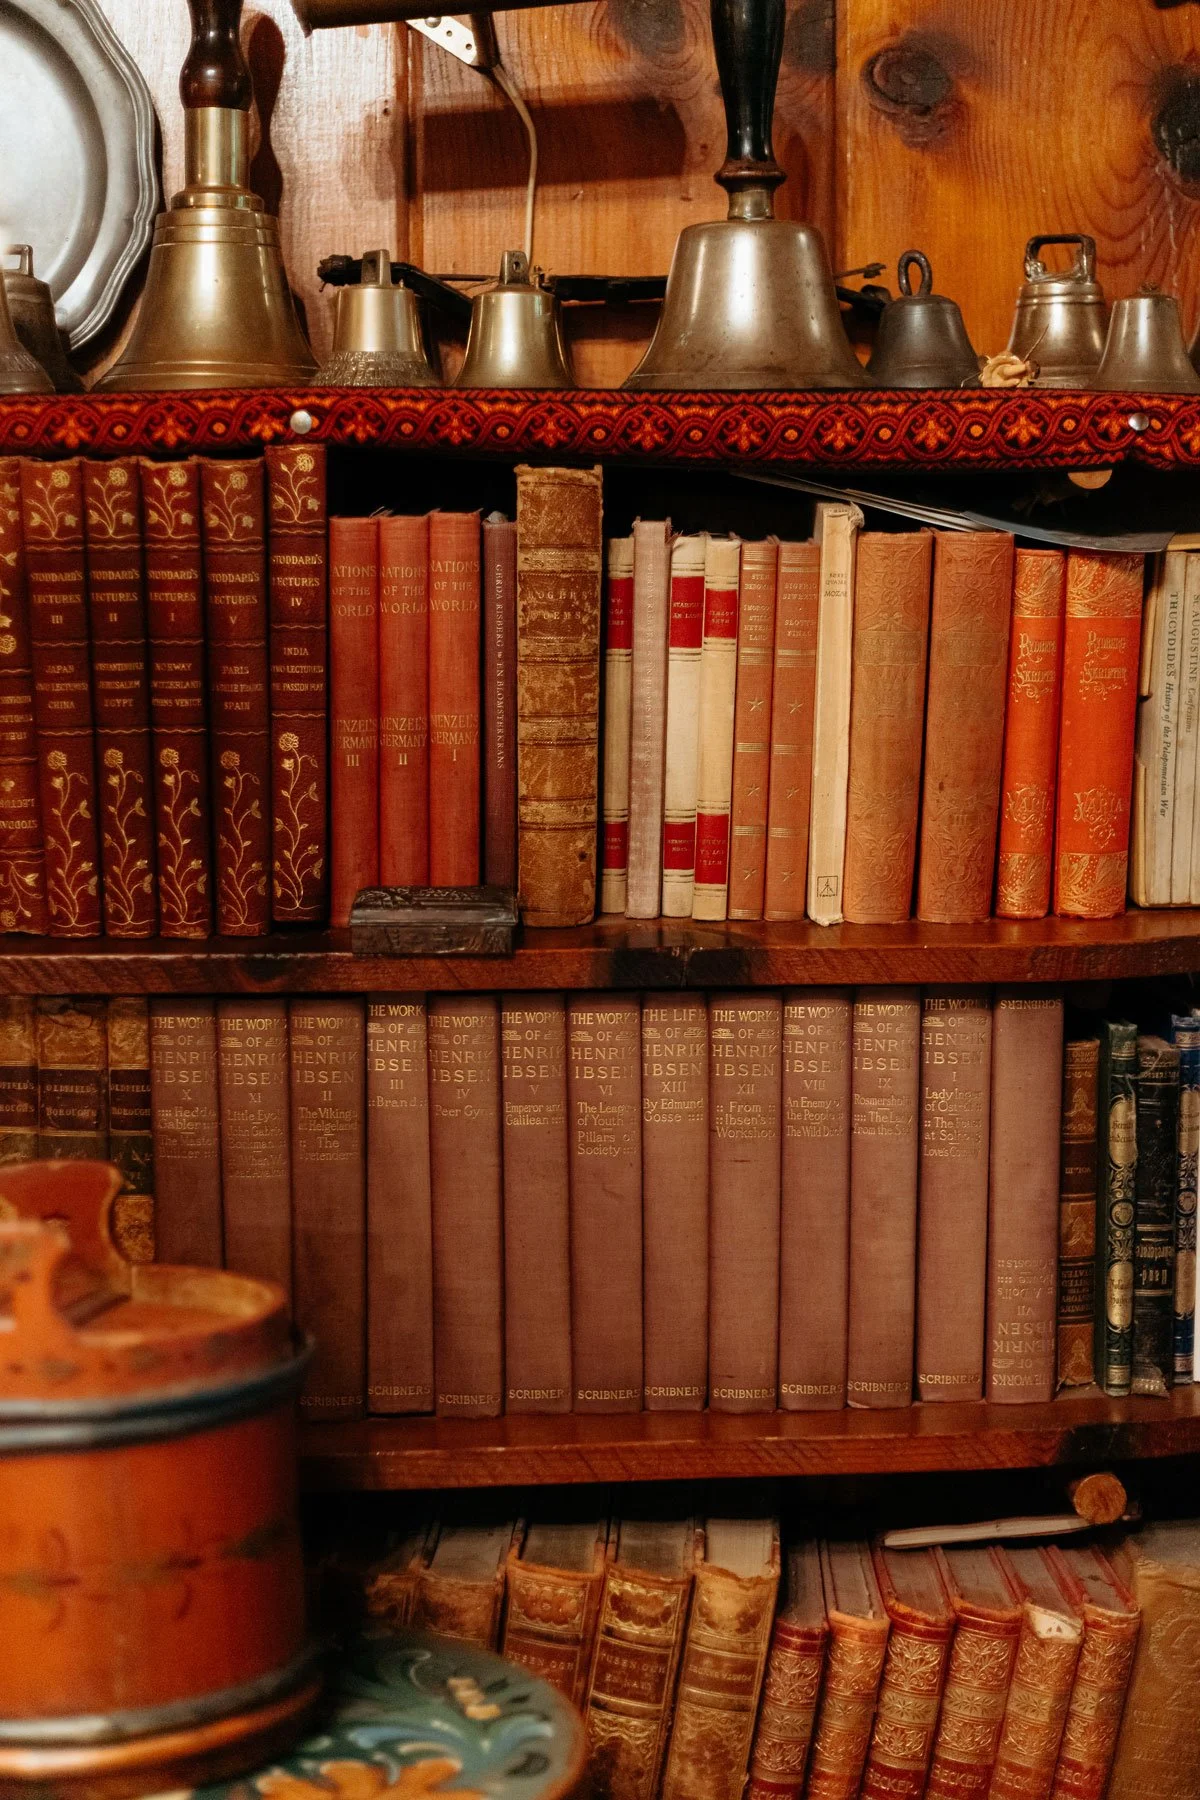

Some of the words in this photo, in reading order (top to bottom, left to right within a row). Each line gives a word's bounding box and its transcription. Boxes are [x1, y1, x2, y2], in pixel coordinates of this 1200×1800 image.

[272, 554, 323, 565] STODDARD'S
[381, 566, 427, 578] NATIONS
[431, 560, 479, 573] NATIONS
[31, 571, 83, 581] STODDARD'S
[148, 569, 199, 580] STODDARD'S
[208, 572, 260, 583] STODDARD'S
[272, 577, 320, 587] LECTURES
[434, 581, 447, 590] OF
[452, 581, 473, 591] THE
[496, 564, 504, 600] GERDA
[332, 587, 346, 596] OF
[348, 586, 370, 596] THE
[384, 586, 397, 596] OF
[402, 586, 425, 596] THE
[32, 594, 81, 604] LECTURES
[91, 592, 138, 602] LECTURES
[150, 592, 196, 602] LECTURES
[210, 595, 258, 605] LECTURES
[291, 597, 302, 606] IV
[380, 602, 428, 614] WORLD
[431, 600, 477, 612] WORLD
[51, 614, 63, 624] III
[109, 613, 118, 622] II
[170, 612, 175, 621] I
[229, 616, 238, 624] V
[496, 604, 504, 647] RISBERG
[1166, 592, 1179, 677] THUCYDIDES
[283, 647, 309, 656] INDIA
[1189, 610, 1200, 683] AUGUSTINE
[46, 664, 75, 673] JAPAN
[154, 663, 192, 671] NORWAY
[222, 666, 249, 674] PARIS
[497, 663, 504, 677] EN
[104, 698, 133, 707] EGYPT
[1162, 682, 1174, 714] History
[48, 701, 75, 709] CHINA
[224, 702, 250, 710] SPAIN
[1185, 687, 1197, 734] Confessions
[497, 681, 505, 769] BLOMSTERKRANS
[1163, 714, 1172, 725] of
[431, 731, 479, 745] GERMANY
[1163, 726, 1172, 739] the
[380, 735, 428, 748] GERMANY
[346, 754, 360, 767] III
[399, 753, 408, 765] II
[452, 749, 457, 761] I
[1159, 740, 1172, 797] Peloponnesian
[1074, 791, 1123, 822] VARIA
[1159, 798, 1169, 818] War
[854, 1004, 875, 1016] THE
[924, 999, 946, 1010] THE
[501, 1012, 522, 1023] THE
[642, 1009, 668, 1021] THE
[713, 1010, 735, 1022] THE
[784, 1006, 805, 1018] THE
[152, 1017, 174, 1028] THE
[221, 1019, 243, 1030] THE
[293, 1017, 314, 1029] THE
[429, 1016, 450, 1028] THE
[571, 1013, 594, 1025] THE
[948, 1017, 964, 1027] OF
[388, 1023, 404, 1034] OF
[665, 1028, 681, 1038] OF
[738, 1028, 754, 1039] OF
[808, 1025, 825, 1035] OF
[877, 1023, 893, 1033] OF
[178, 1035, 194, 1045] OF
[453, 1035, 469, 1045] OF
[525, 1030, 541, 1040] OF
[596, 1031, 612, 1041] OF
[922, 1033, 986, 1045] HENRIK
[246, 1037, 262, 1048] OF
[317, 1036, 333, 1046] OF
[853, 1039, 914, 1052] HENRIK
[502, 1046, 565, 1058] HENRIK
[643, 1043, 705, 1057] HENRIK
[712, 1044, 778, 1057] HENRIK
[783, 1041, 846, 1053] HENRIK
[152, 1051, 217, 1064] HENRIK
[292, 1051, 358, 1065] HENRIK
[571, 1047, 638, 1060] HENRIK
[925, 1052, 983, 1064] IBSEN
[221, 1053, 288, 1066] HENRIK
[854, 1057, 912, 1071] IBSEN
[503, 1065, 562, 1078] IBSEN
[643, 1063, 702, 1076] IBSEN
[715, 1063, 775, 1076] IBSEN
[156, 1071, 215, 1083] IBSEN
[225, 1072, 284, 1085] IBSEN
[296, 1070, 354, 1083] IBSEN
[46, 1083, 98, 1093] OLDFIELD'S
[390, 1079, 404, 1090] III
[661, 1081, 687, 1093] XIII
[736, 1083, 755, 1095] XII
[878, 1078, 892, 1089] IX
[182, 1089, 192, 1100] X
[457, 1089, 470, 1099] IV
[529, 1085, 539, 1095] V
[600, 1085, 613, 1096] VI
[925, 1087, 953, 1100] Lady
[323, 1091, 332, 1101] II
[376, 1096, 417, 1107] Brand
[505, 1102, 544, 1114] Emperor
[578, 1102, 598, 1114] The
[643, 1098, 658, 1112] By
[661, 1098, 704, 1110] Edmund
[729, 1102, 762, 1112] From
[785, 1097, 799, 1107] An
[800, 1097, 832, 1110] Enemy
[924, 1101, 935, 1111] of
[299, 1107, 318, 1119] The
[644, 1111, 682, 1123] Gosse
[787, 1110, 801, 1120] the
[869, 1111, 888, 1123] The
[505, 1115, 549, 1125] Galilean
[578, 1116, 590, 1126] of
[592, 1115, 624, 1126] Youth
[725, 1113, 766, 1125] Ibsen's
[935, 1117, 954, 1128] The
[716, 1126, 776, 1140] Workshop
[786, 1126, 801, 1136] The
[801, 1125, 821, 1137] Wild
[853, 1124, 876, 1135] from
[877, 1124, 893, 1135] the
[317, 1136, 340, 1148] The
[578, 1131, 616, 1142] Pillars
[577, 1143, 621, 1157] Society
[923, 1146, 949, 1157] Love's
[1016, 1305, 1033, 1316] VII
[998, 1321, 1053, 1335] IBSEN
[992, 1339, 1054, 1353] HENRIK
[1015, 1358, 1032, 1369] OF
[920, 1374, 982, 1385] SCRIBNERS
[991, 1374, 1031, 1386] WORKS
[368, 1385, 431, 1396] SCRIBNERS
[781, 1384, 843, 1394] SCRIBNERS
[847, 1381, 910, 1392] SCRIBNERS
[578, 1389, 641, 1400] SCRIBNERS
[713, 1388, 776, 1399] SCRIBNERS
[300, 1396, 363, 1406] SCRIBNERS
[439, 1394, 501, 1405] SCRIBNERS
[549, 1659, 574, 1670] OCH
[600, 1652, 637, 1669] TUSEN
[641, 1663, 665, 1674] OCH
